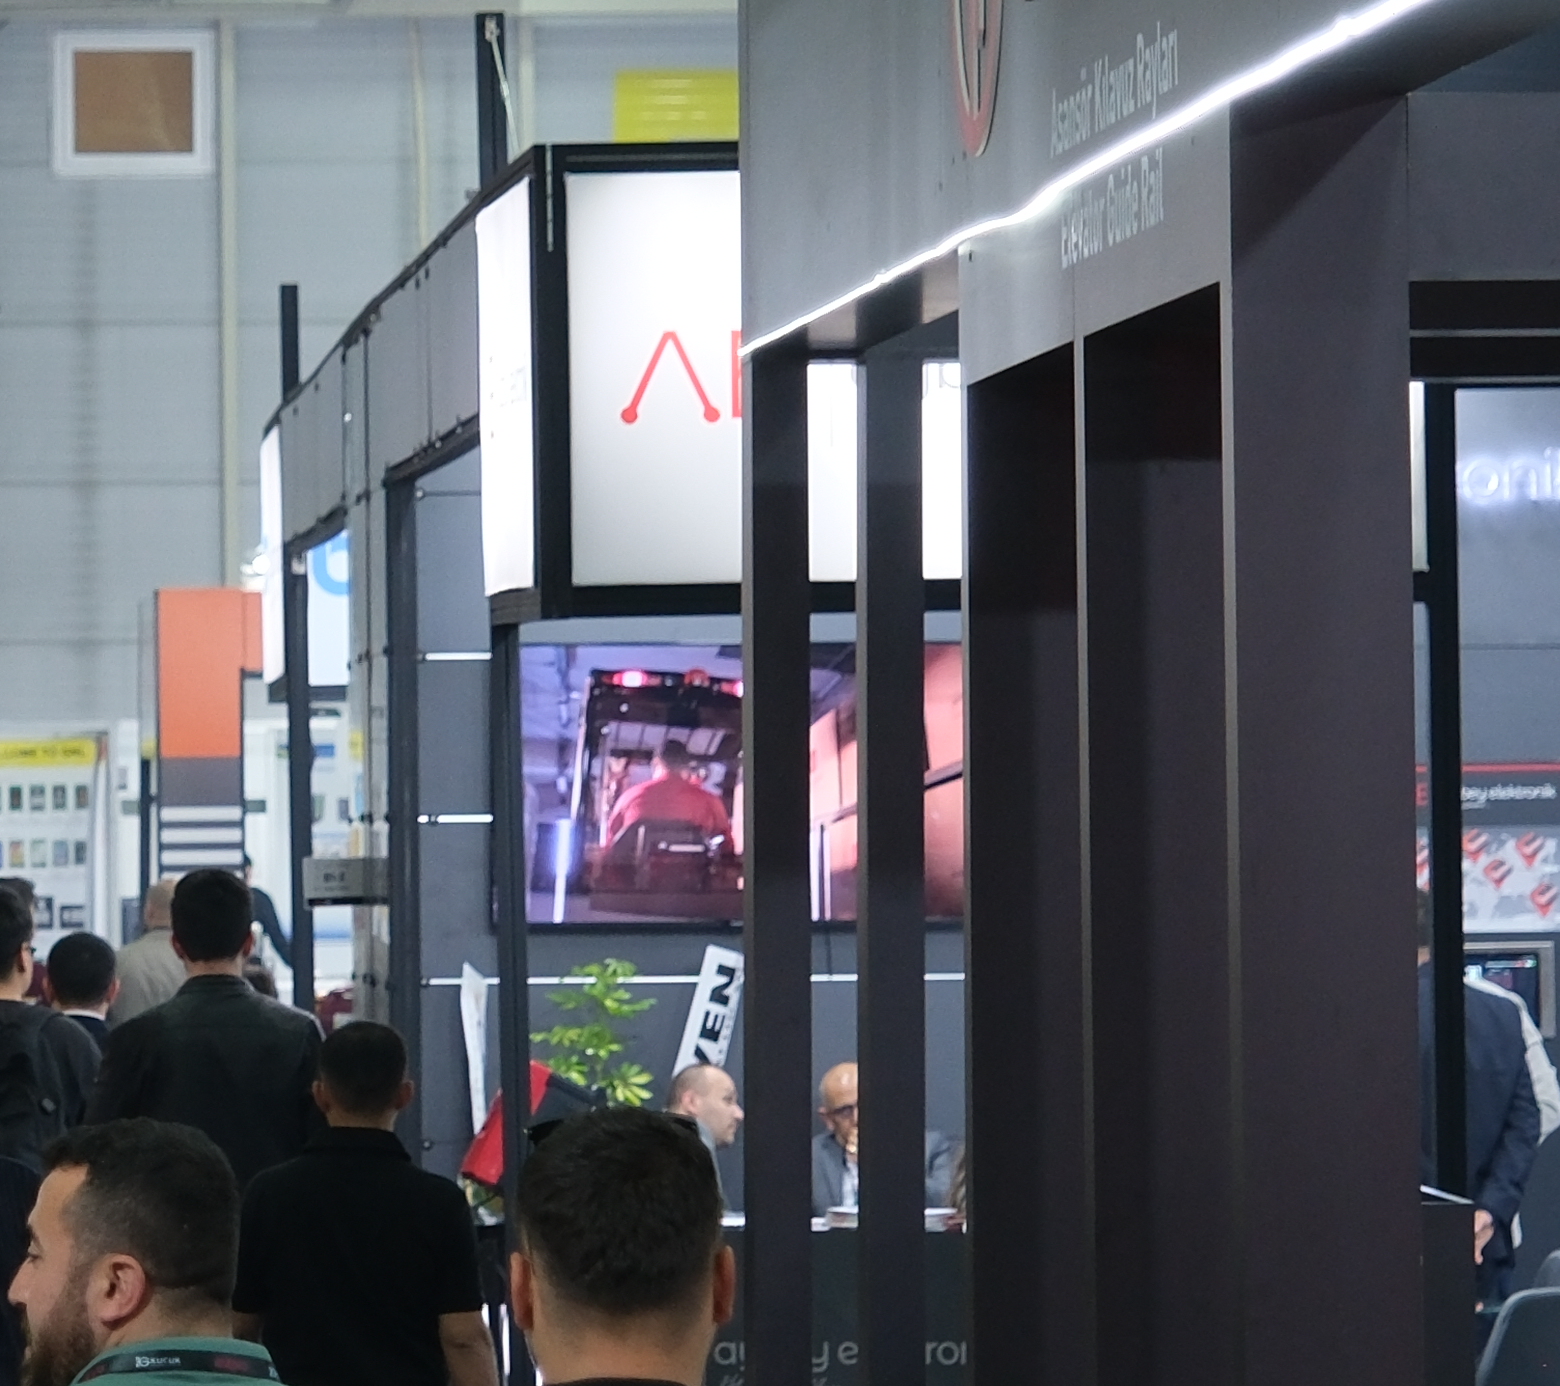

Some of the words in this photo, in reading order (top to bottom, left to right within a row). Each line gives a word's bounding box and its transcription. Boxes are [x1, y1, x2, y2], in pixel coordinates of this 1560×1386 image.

[1051, 67, 1093, 159] Asansör
[1106, 165, 1140, 247] Guide
[1141, 147, 1164, 231] Rail
